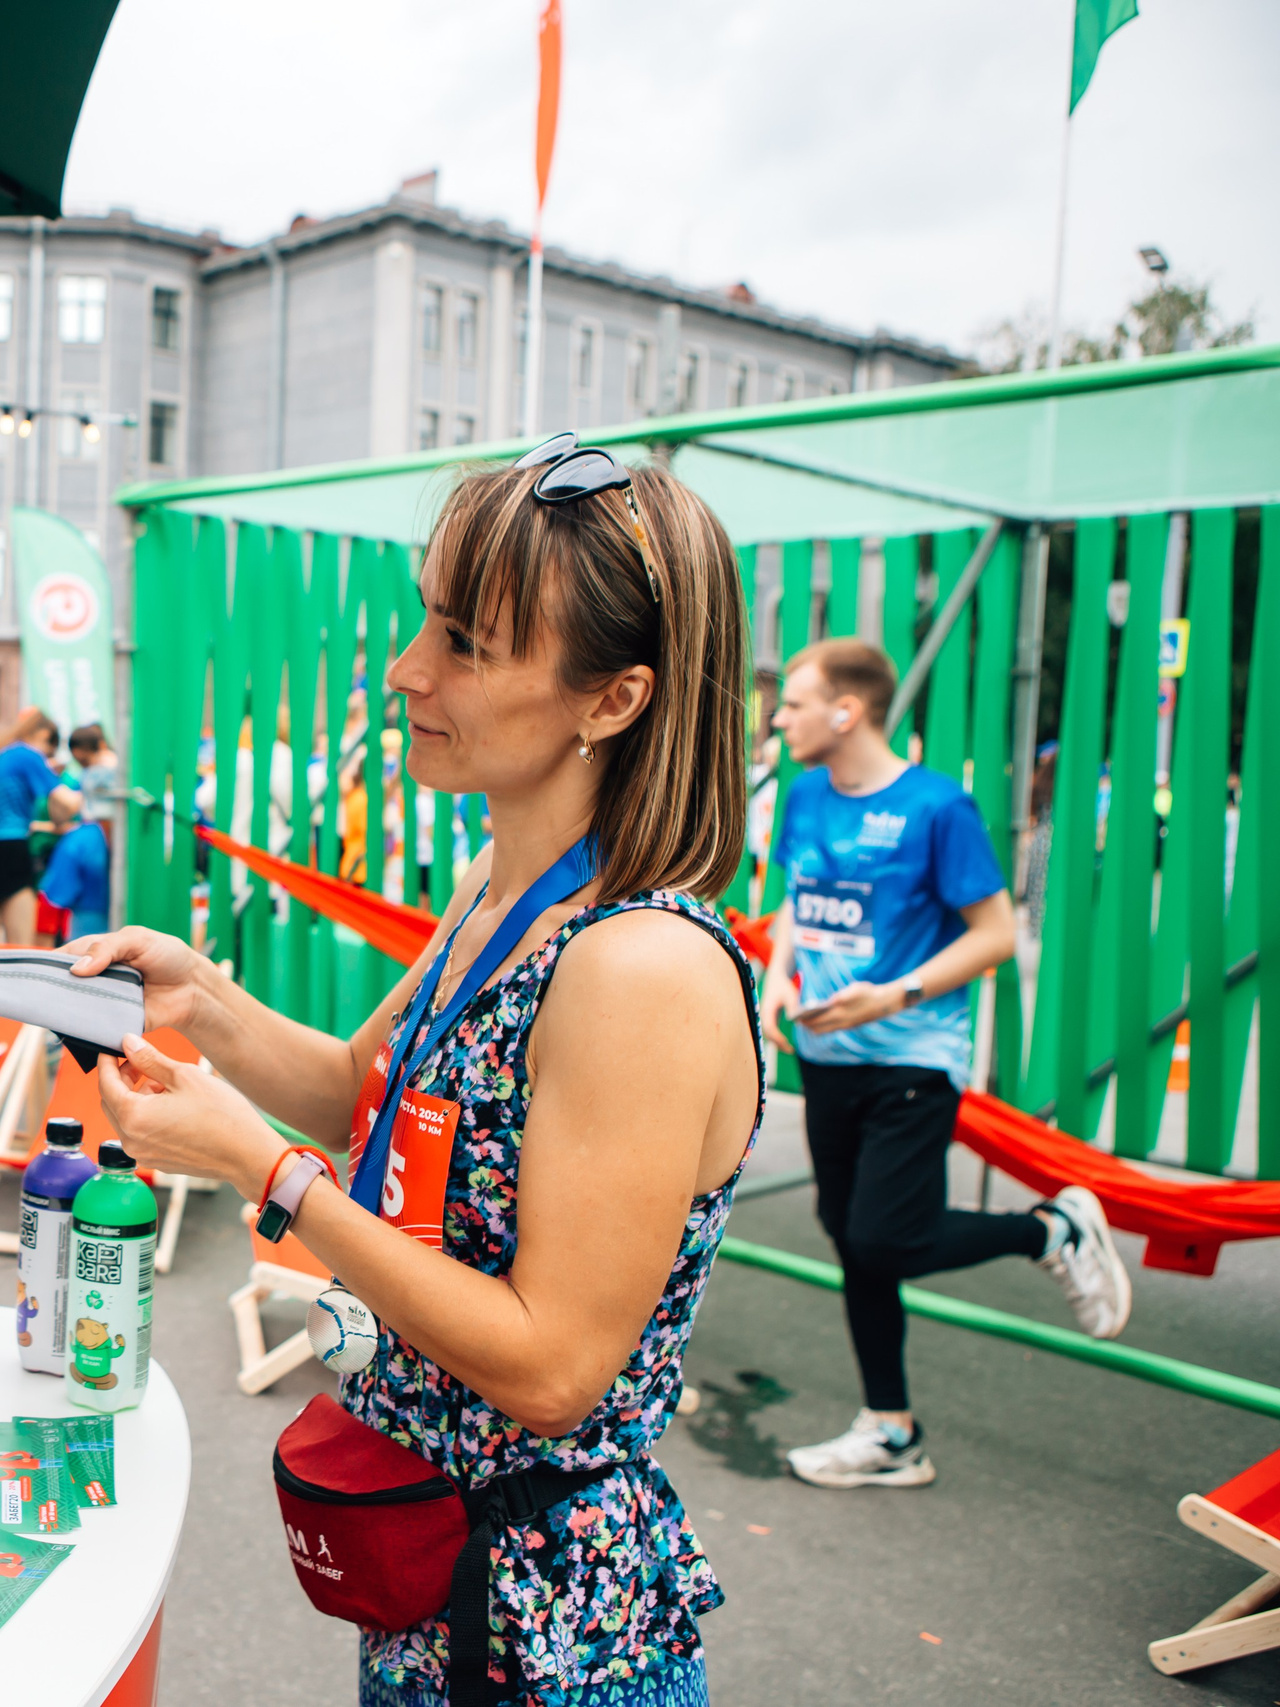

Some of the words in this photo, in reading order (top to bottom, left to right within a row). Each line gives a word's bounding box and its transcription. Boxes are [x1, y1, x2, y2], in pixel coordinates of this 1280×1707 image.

[418, 1108, 445, 1125] 2024
[418, 1121, 426, 1132] 10
[428, 1124, 442, 1136] КМ
[382, 1146, 406, 1218] 5
[9, 1494, 19, 1521] ЗАБЕГ20
[315, 1563, 344, 1581] ЗАБЕГ
